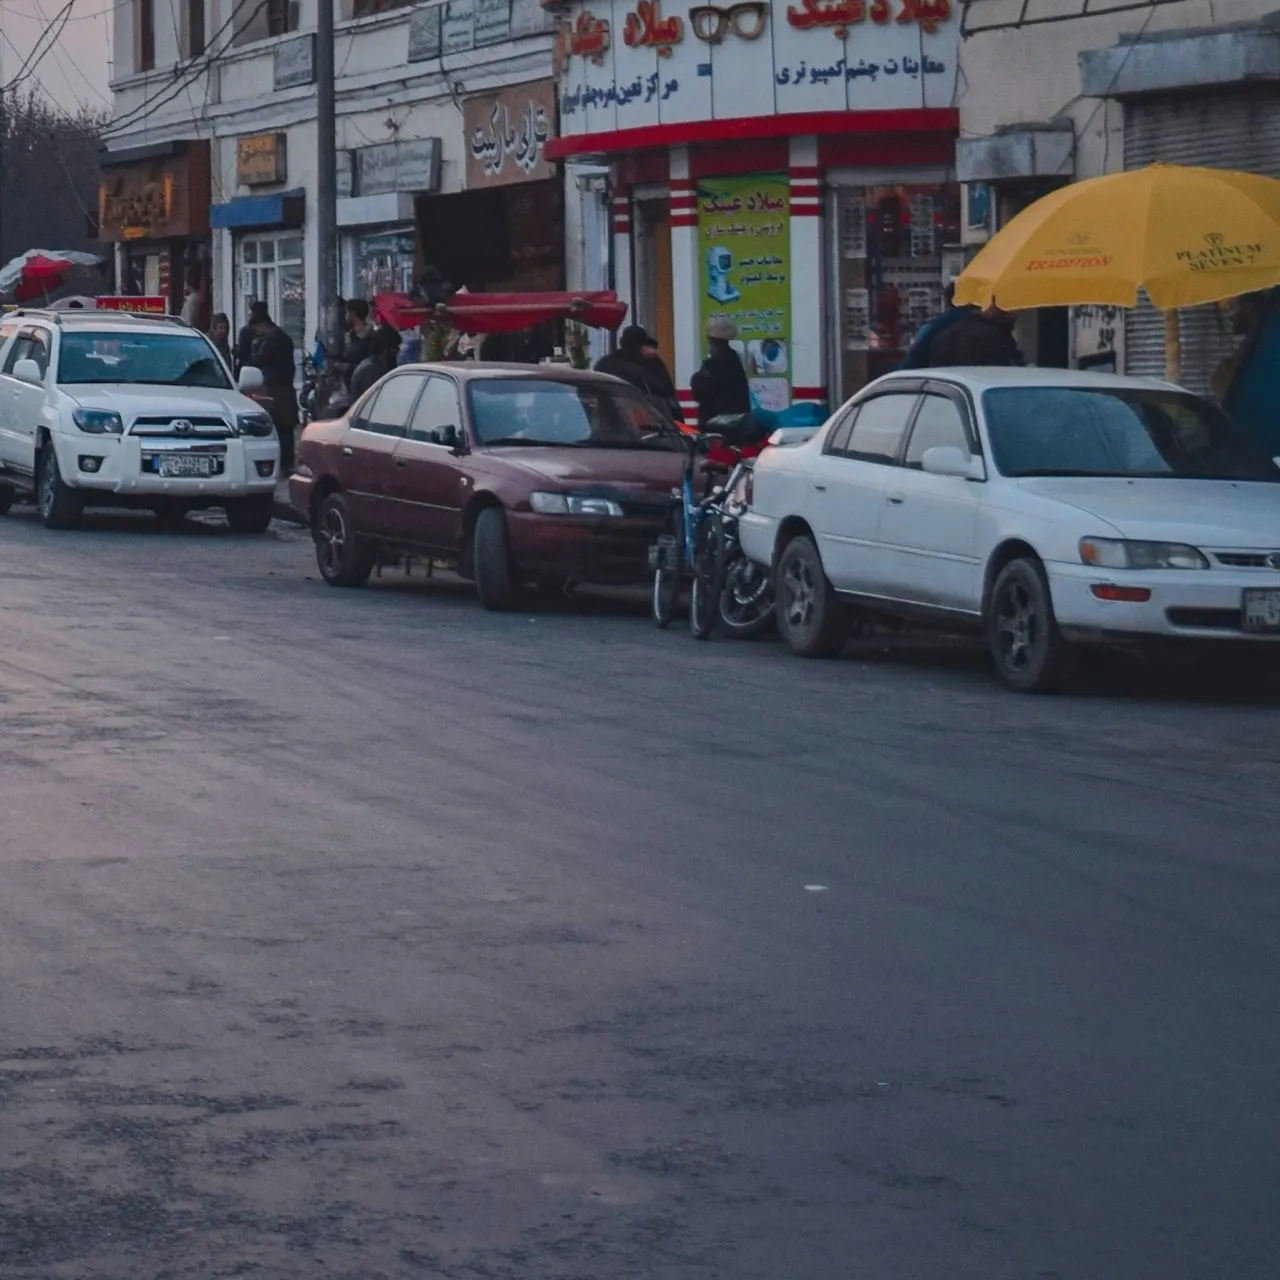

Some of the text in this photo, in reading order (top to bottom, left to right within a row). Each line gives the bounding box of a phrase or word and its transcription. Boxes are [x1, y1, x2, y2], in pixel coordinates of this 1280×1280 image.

[1176, 244, 1262, 261] PLATINUM
[1026, 253, 1113, 271] TRADITION
[1188, 257, 1243, 272] SEVEN
